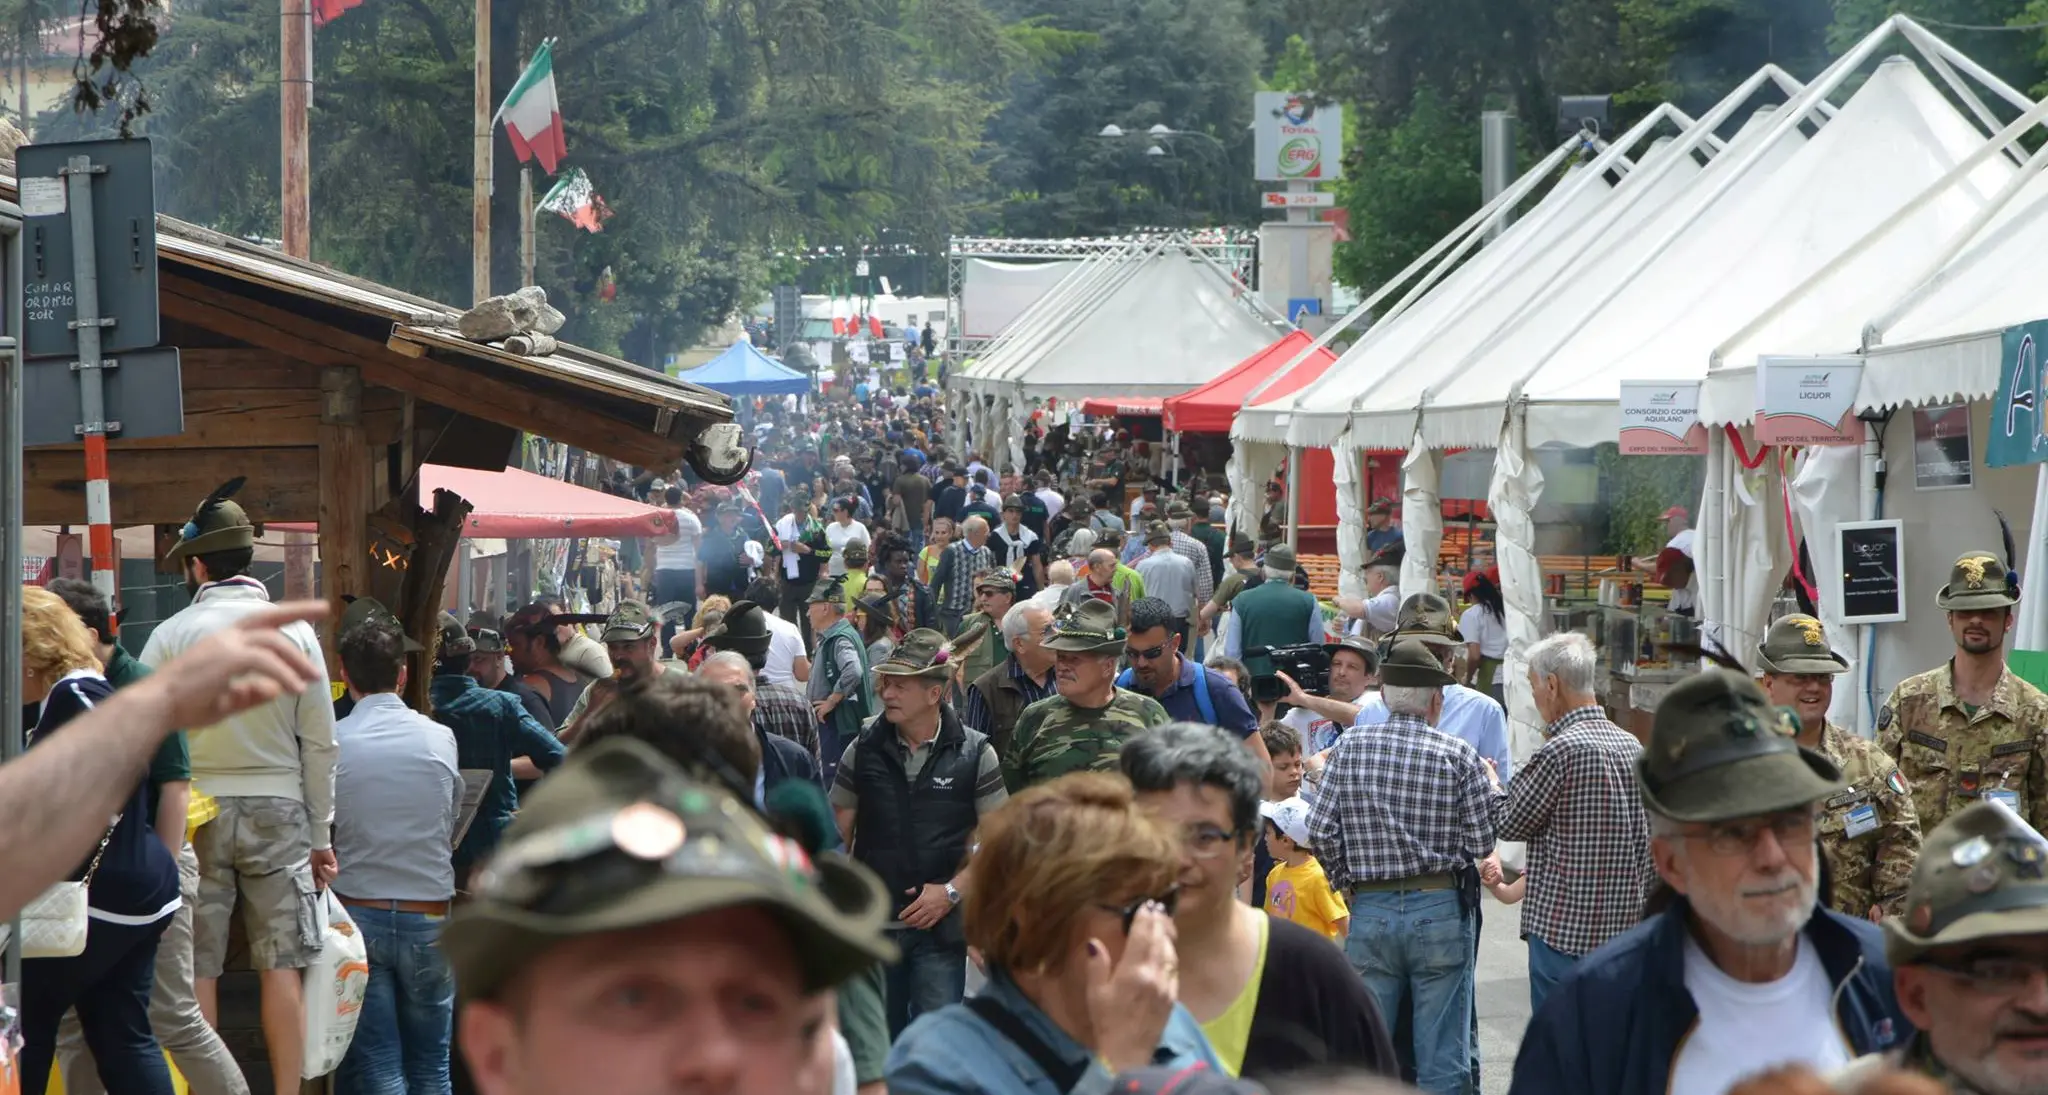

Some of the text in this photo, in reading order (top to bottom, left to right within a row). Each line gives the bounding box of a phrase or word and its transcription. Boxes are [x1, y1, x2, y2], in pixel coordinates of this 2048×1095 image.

[1281, 126, 1319, 134] TOTAL
[1287, 150, 1316, 161] ERG
[1625, 408, 1670, 416] CONSORZIO
[1811, 435, 1854, 443] TERRITORIO
